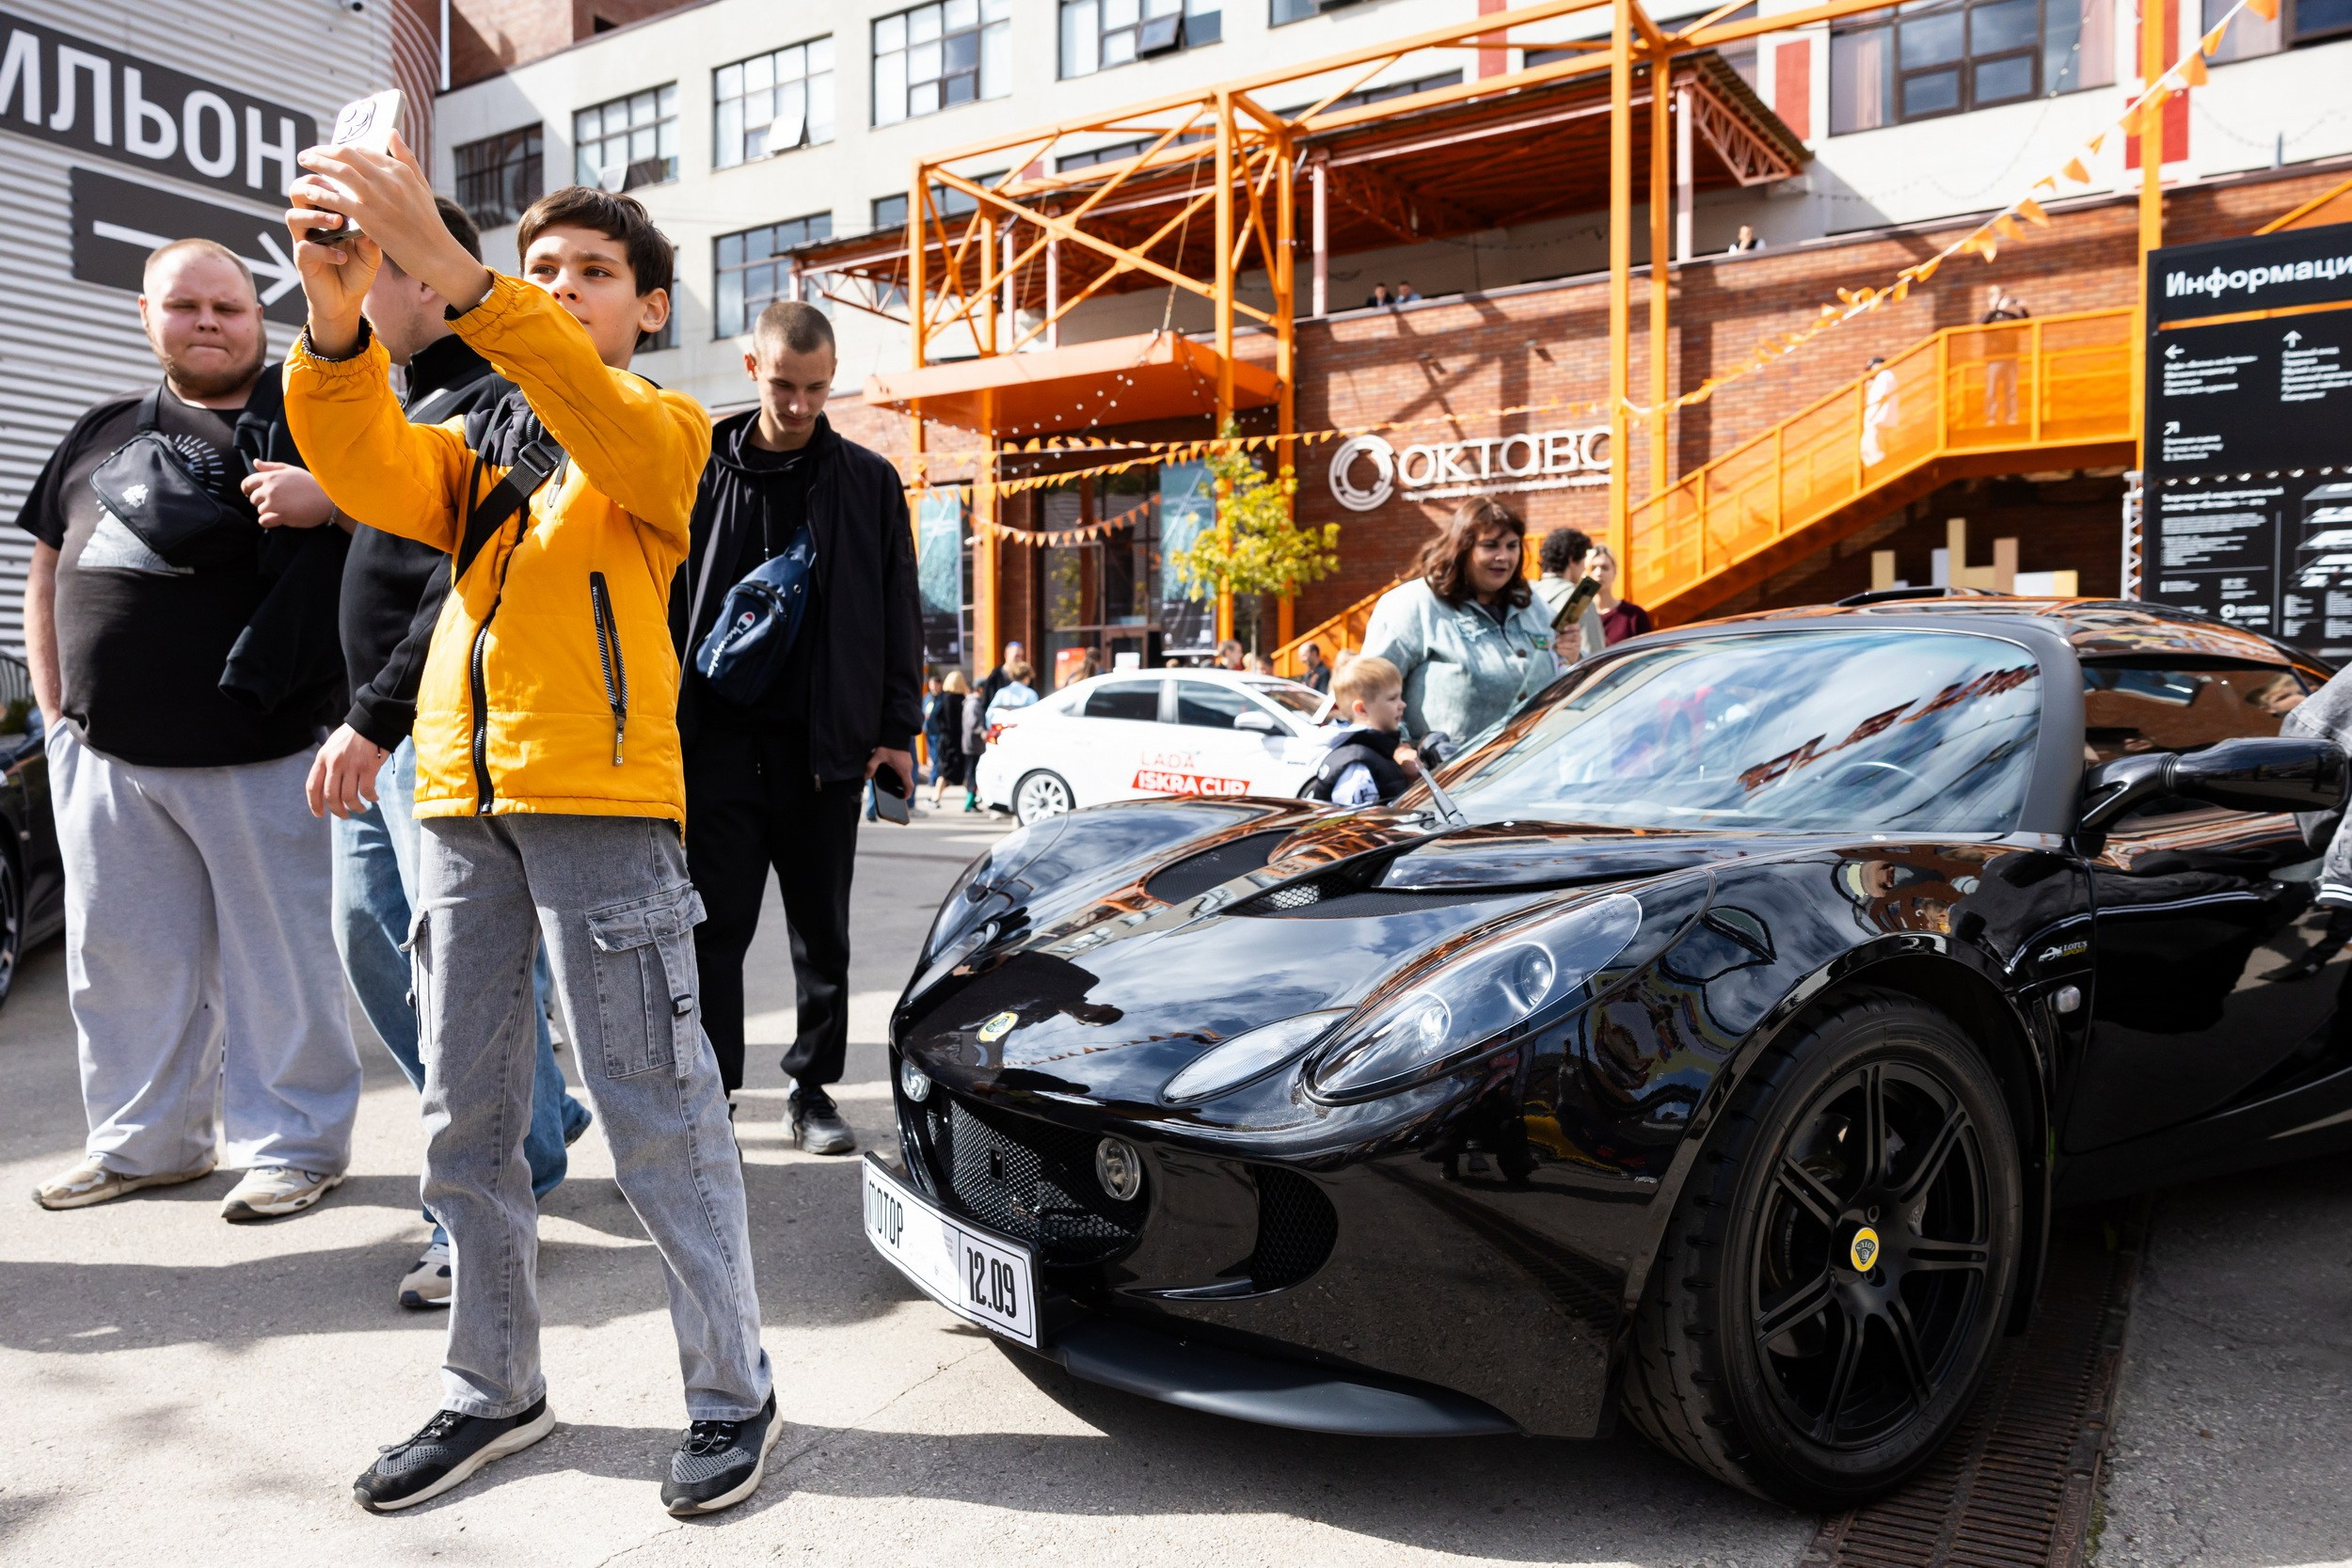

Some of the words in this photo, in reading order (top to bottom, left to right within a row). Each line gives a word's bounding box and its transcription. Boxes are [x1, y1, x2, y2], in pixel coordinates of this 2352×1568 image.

[707, 611, 755, 678] Champion
[1140, 752, 1196, 769] LADA
[1137, 770, 1200, 796] ISKRA
[1199, 777, 1247, 797] CUP
[2063, 941, 2088, 952] LOTUS
[967, 1246, 1017, 1319] 12.09
